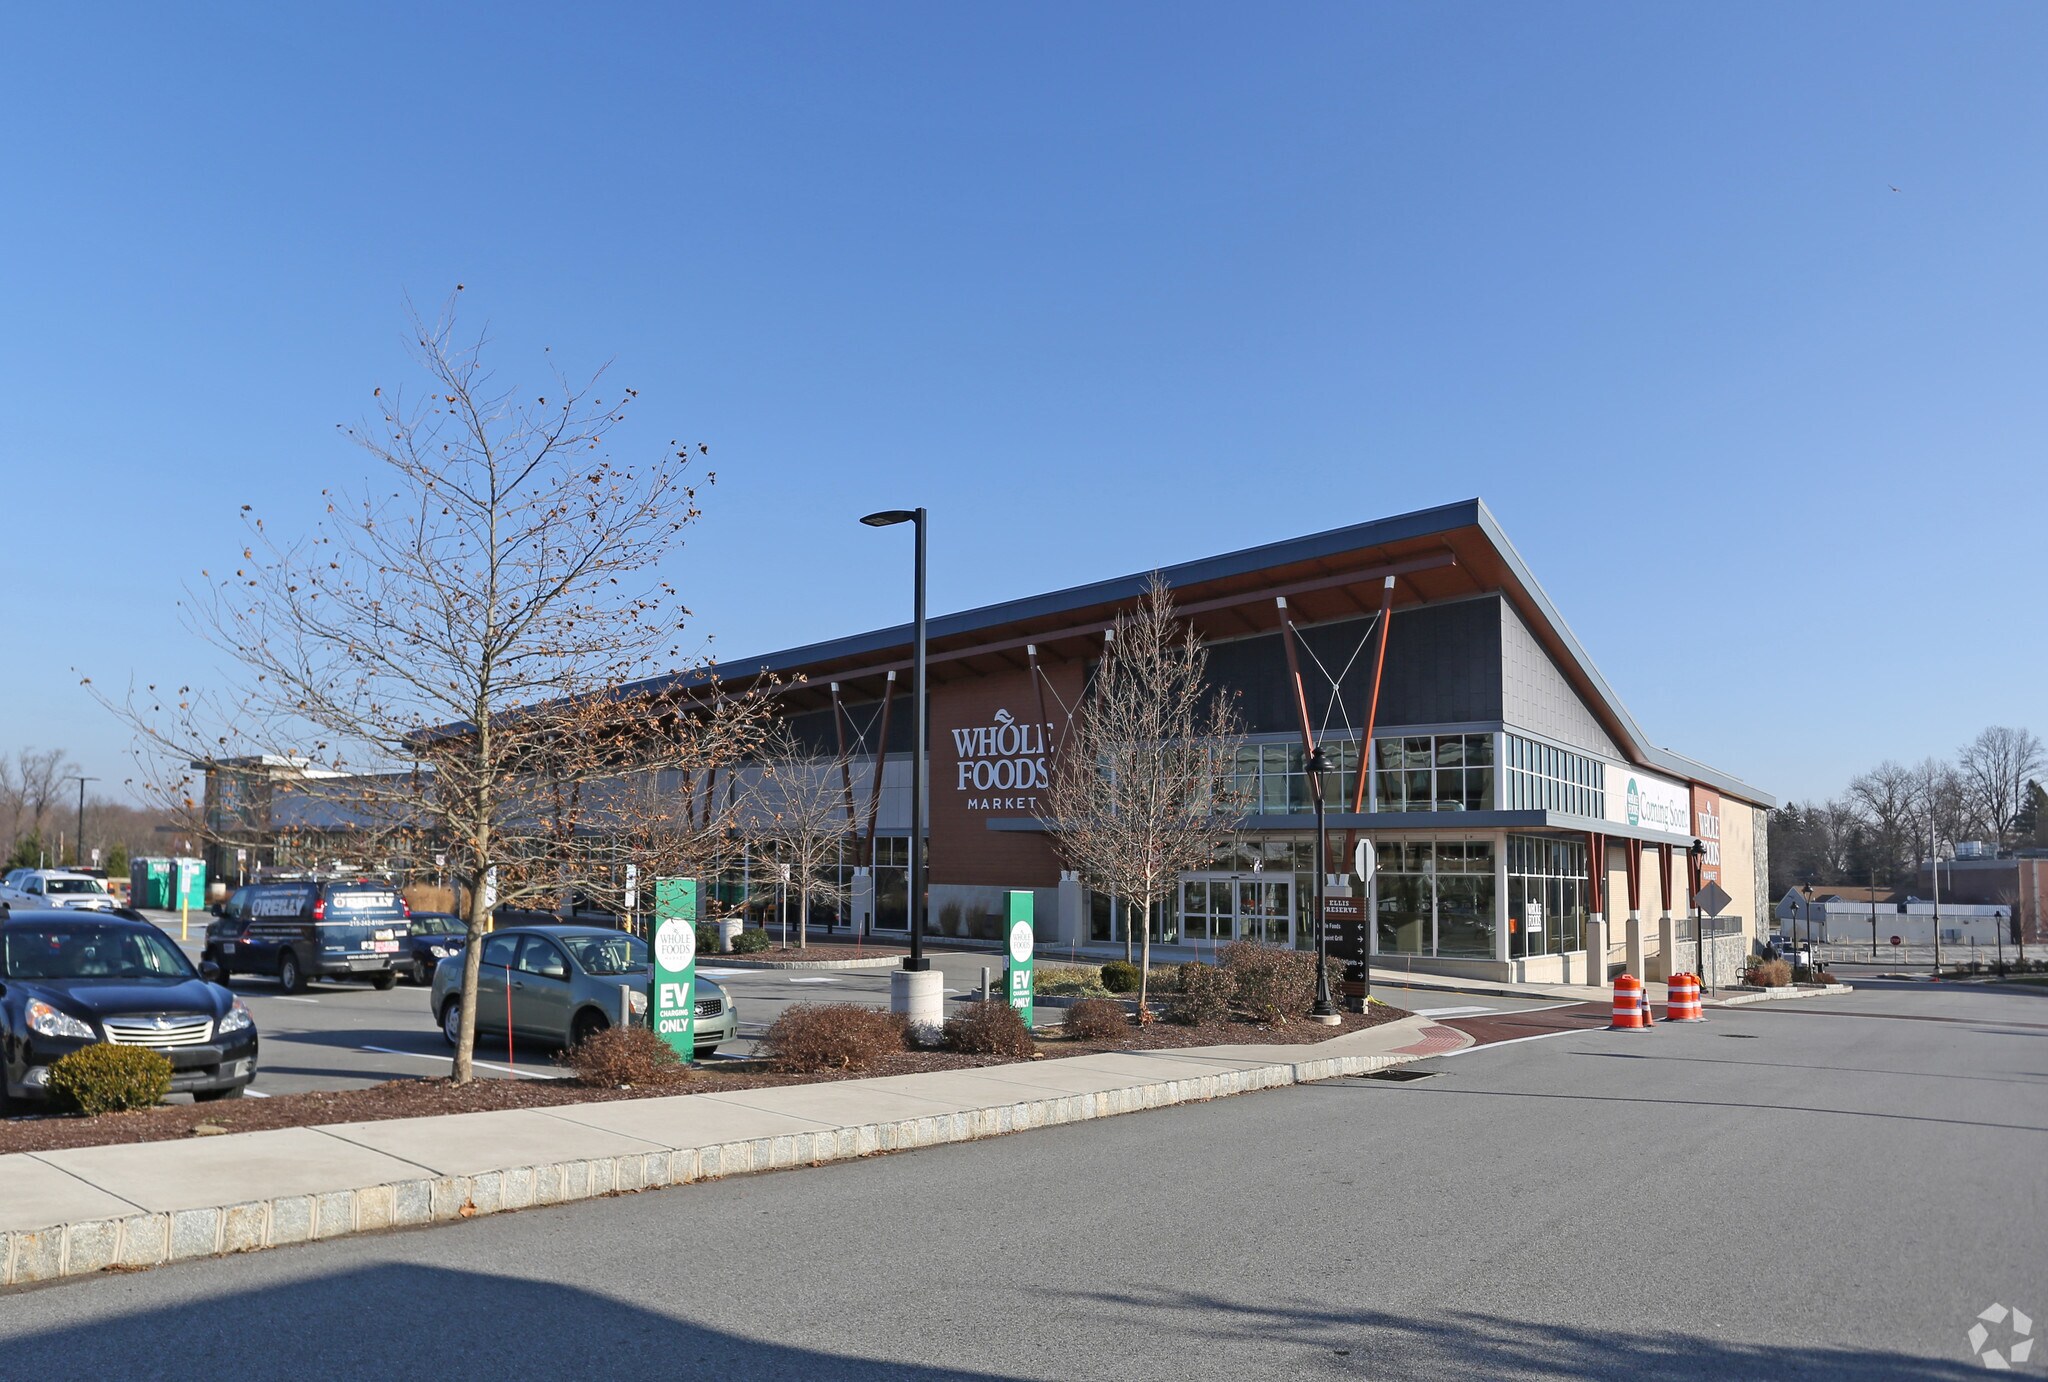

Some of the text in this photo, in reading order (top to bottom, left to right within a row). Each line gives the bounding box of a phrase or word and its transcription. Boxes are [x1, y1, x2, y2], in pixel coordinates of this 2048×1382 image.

[957, 758, 1049, 790] FOODS
[967, 797, 1036, 810] MARKET
[1640, 791, 1688, 832] Coming Soon!
[1696, 811, 1720, 840] WHOLE
[660, 934, 691, 944] WHOLE
[661, 944, 691, 954] FOODS
[1013, 970, 1031, 990] EV
[660, 982, 690, 1008] EV
[1013, 997, 1030, 1009] ONLY
[660, 1008, 689, 1018] CHARGING
[659, 1018, 690, 1034] ONLY
